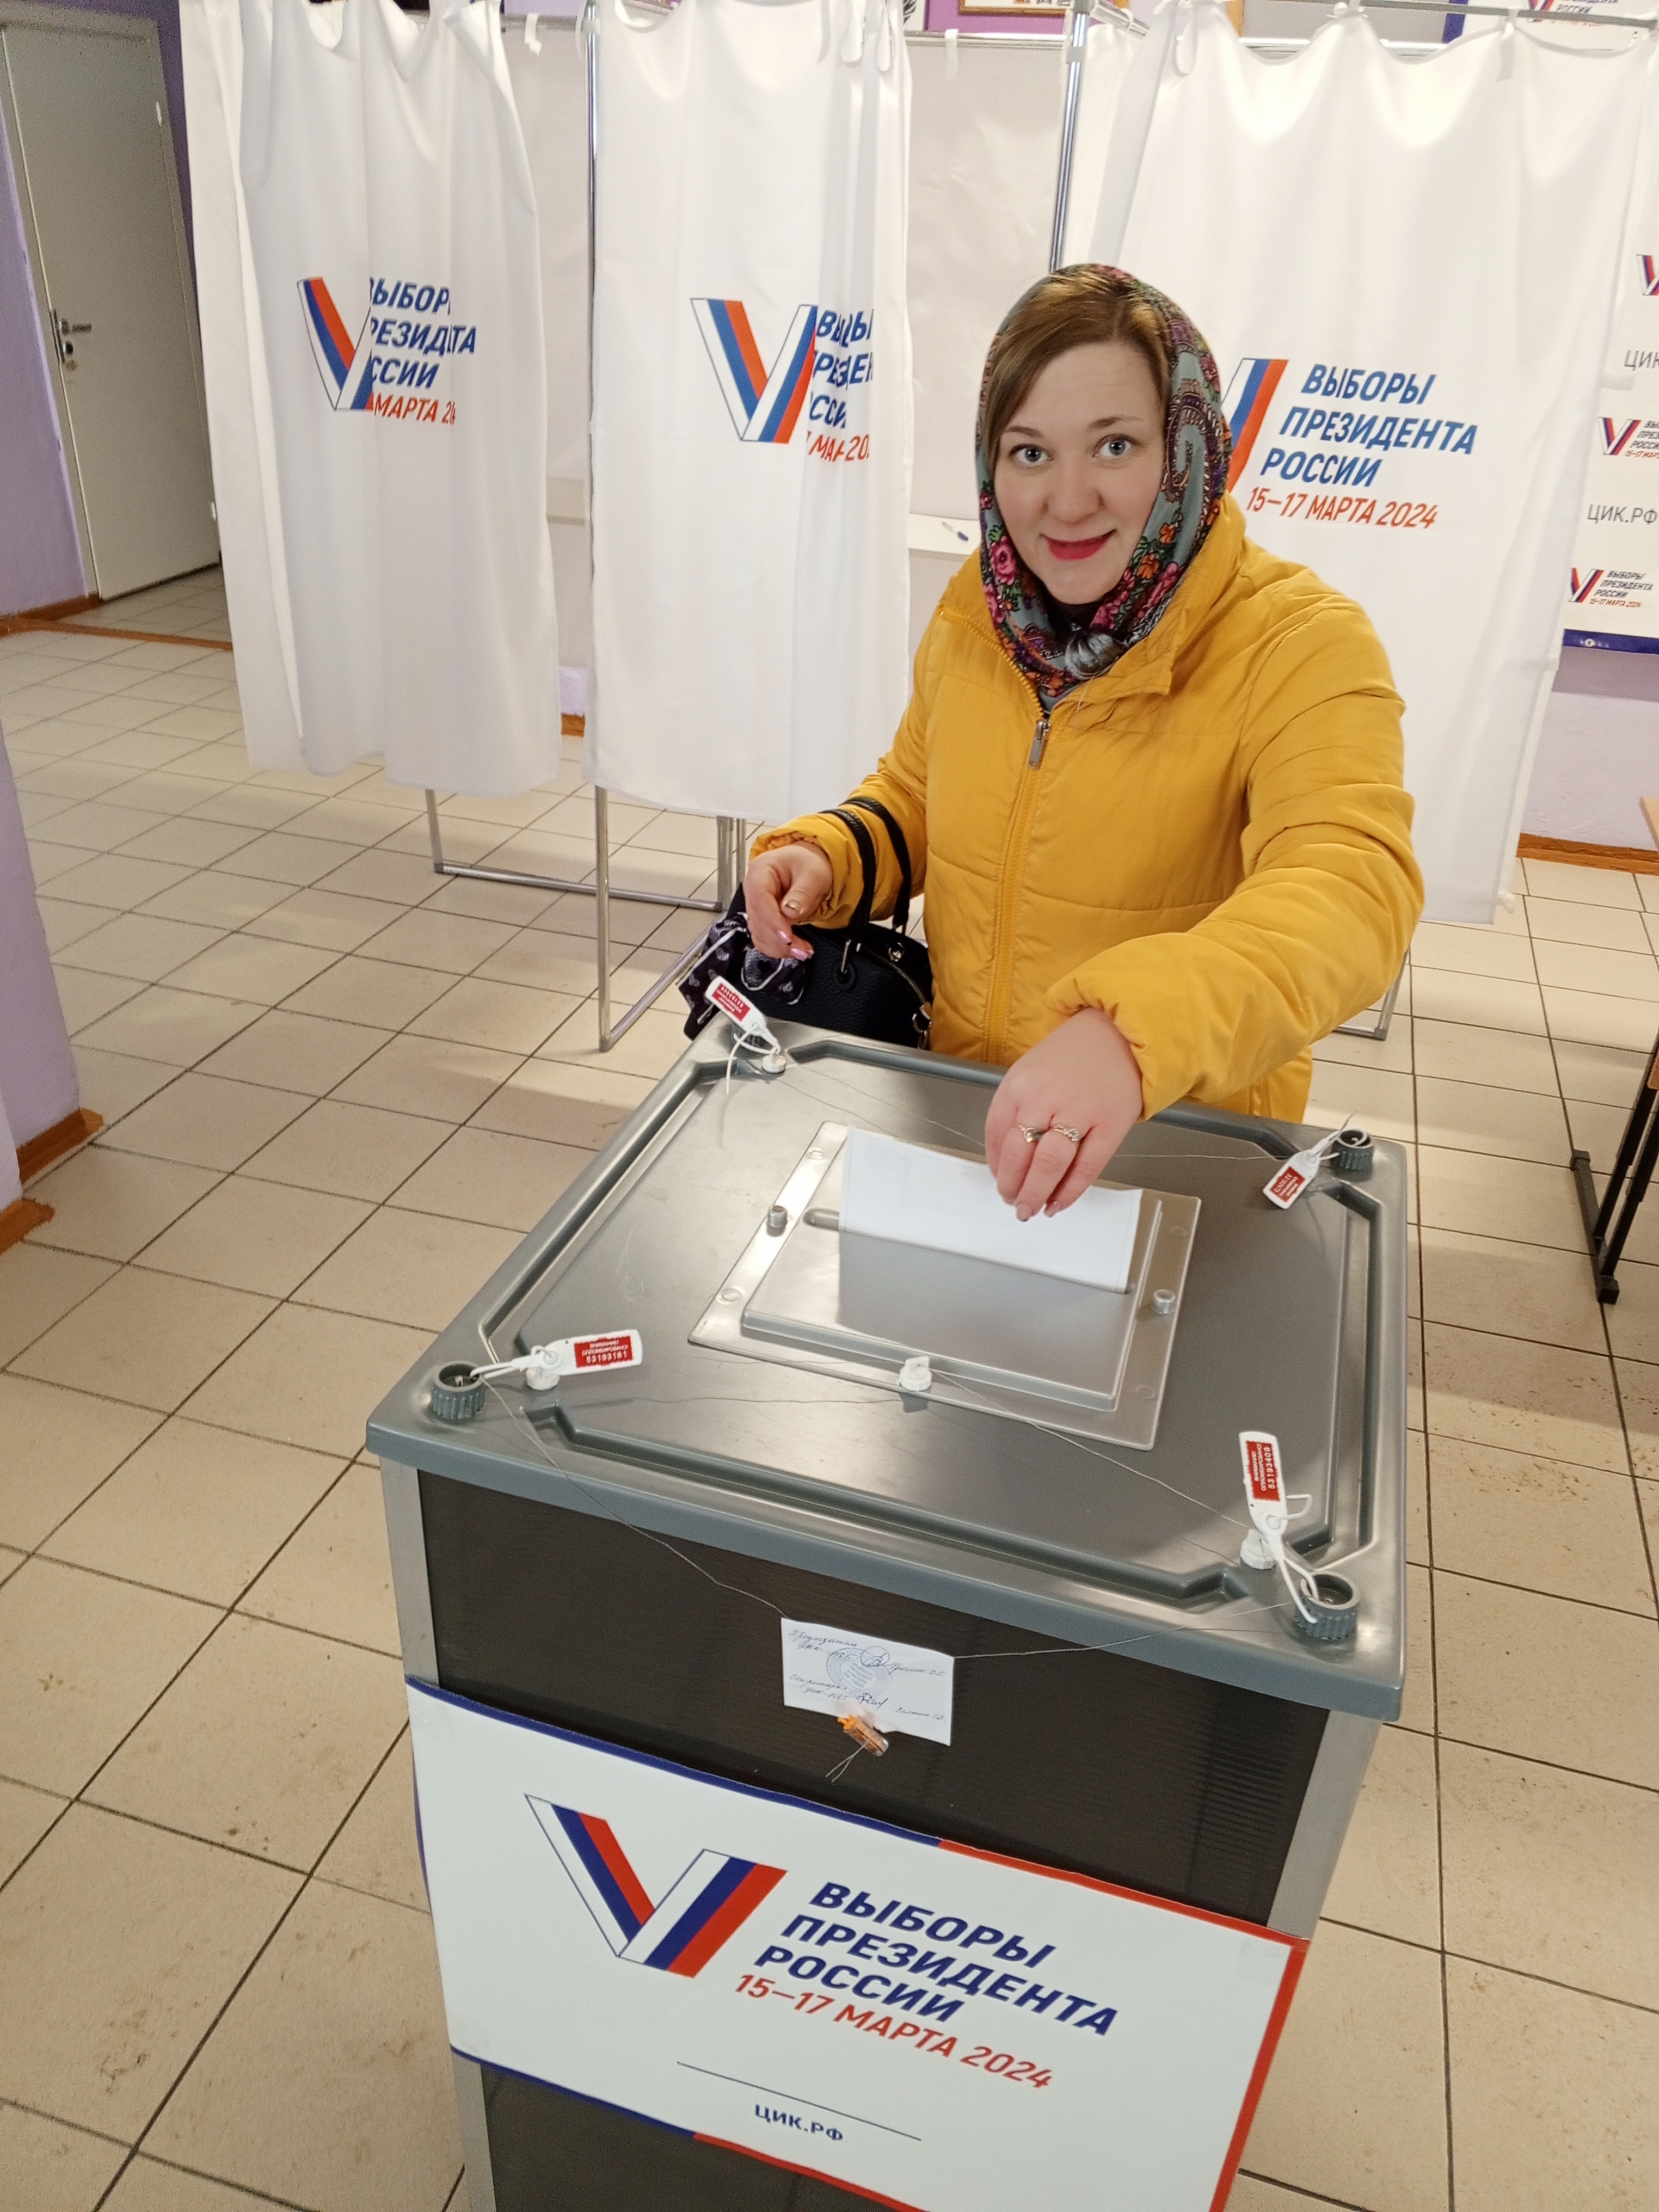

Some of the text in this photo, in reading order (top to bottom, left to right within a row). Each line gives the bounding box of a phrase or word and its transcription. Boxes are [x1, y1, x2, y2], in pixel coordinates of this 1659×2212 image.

[369, 276, 450, 316] ЫБОР
[1301, 364, 1437, 405] ВЫБОРЫ
[374, 393, 439, 422] МАРТА
[1279, 406, 1478, 455] ПРЕЗИДЕНТА
[1260, 448, 1382, 487] РОССИИ
[1305, 495, 1377, 525] МАРТА
[1375, 501, 1439, 529] 2024
[1587, 504, 1657, 524] ЦИК.РФ
[1594, 589, 1629, 598] РОССИИ
[1600, 580, 1653, 591] ПРЕЗИДЕНТА
[1607, 570, 1645, 580] ВЫБОРЫ
[809, 1881, 1055, 1969] ВЫБОРЫ
[754, 1945, 966, 2023] РОССИИ
[780, 1914, 1118, 2037] ПРЕЗИДЕНТА
[833, 2005, 958, 2058] МАРТА
[960, 2046, 1053, 2090] 2024
[754, 2104, 844, 2141] ЦИК.РФ
